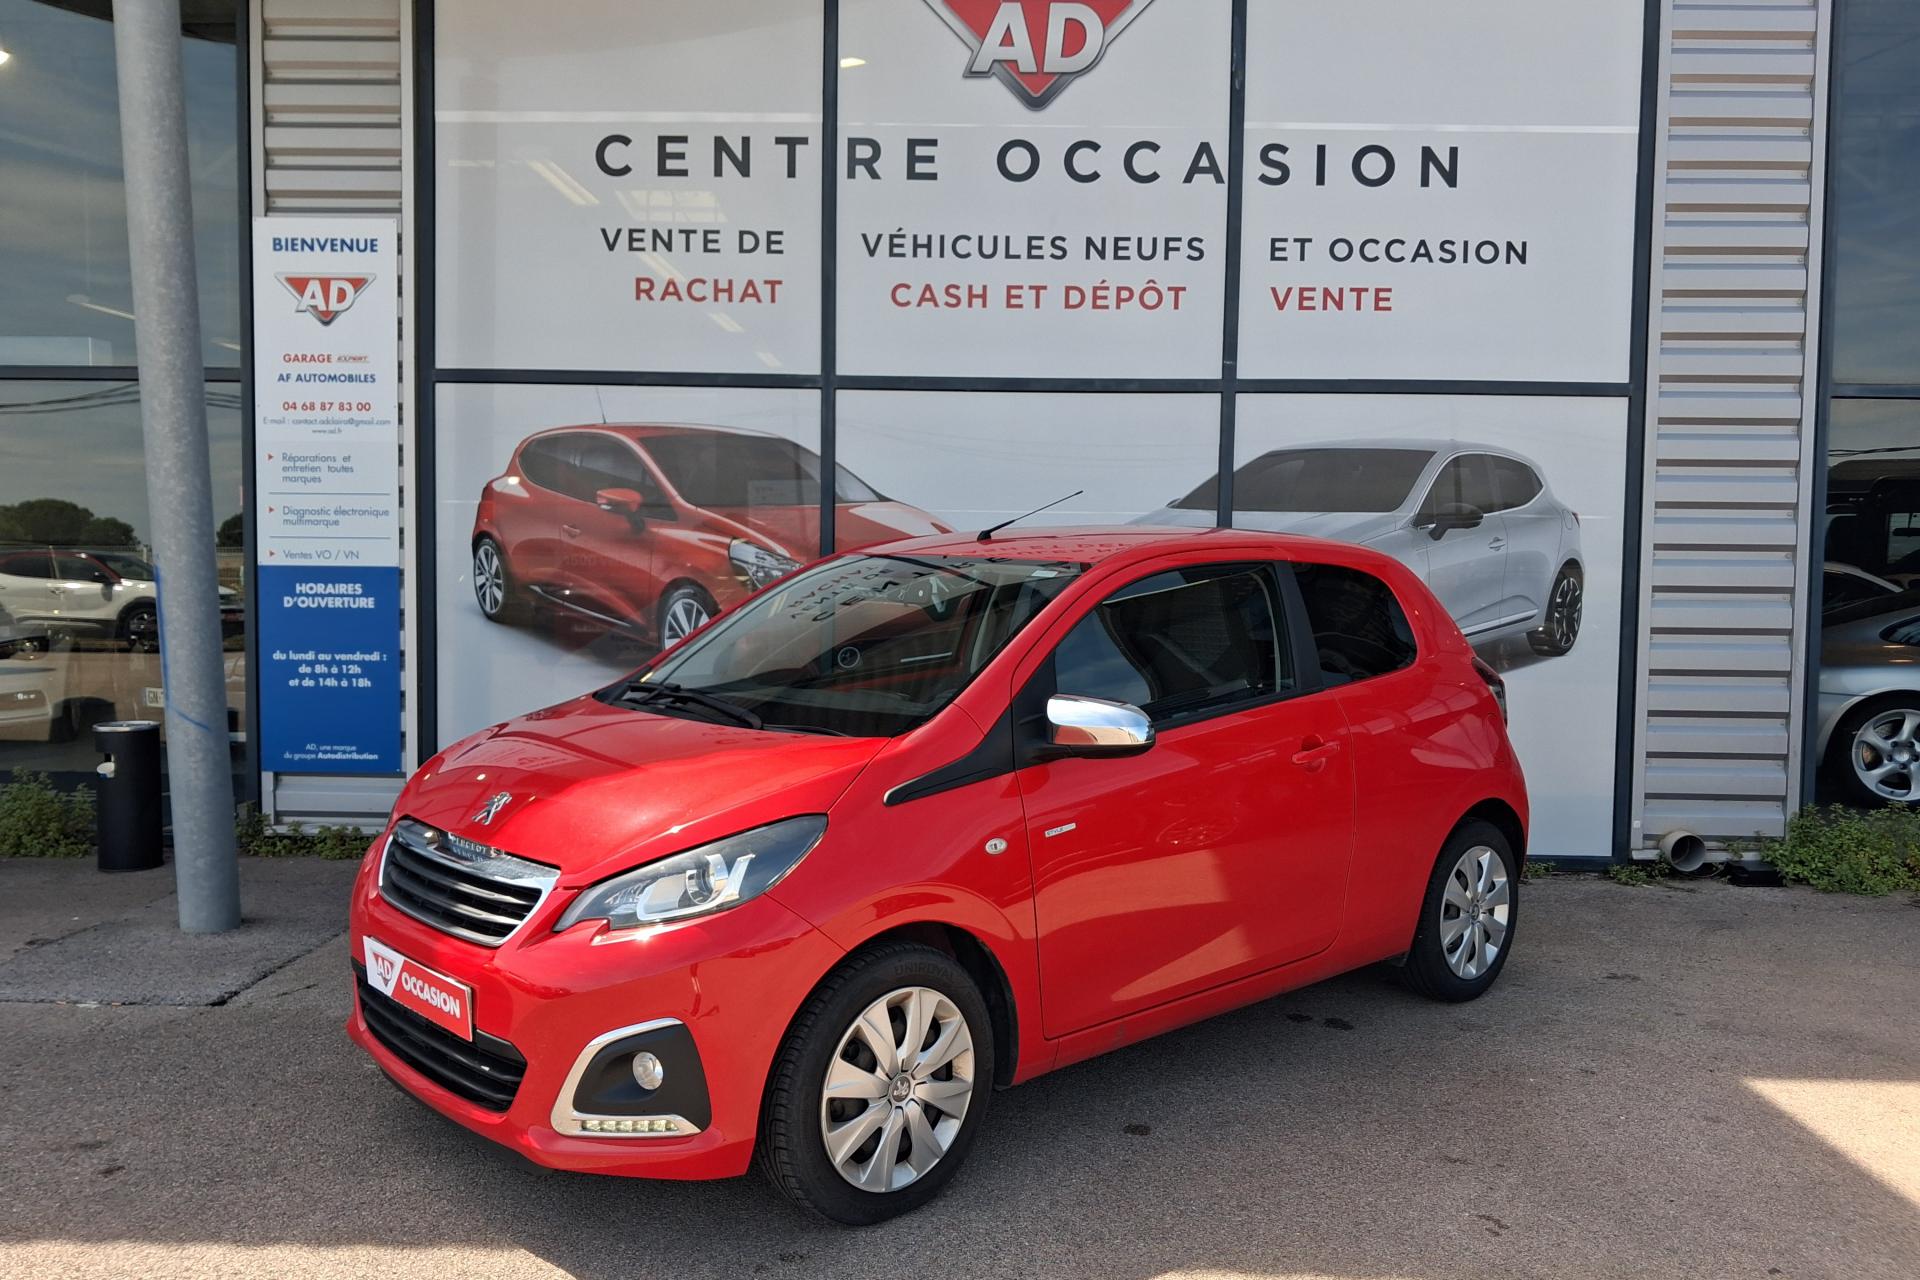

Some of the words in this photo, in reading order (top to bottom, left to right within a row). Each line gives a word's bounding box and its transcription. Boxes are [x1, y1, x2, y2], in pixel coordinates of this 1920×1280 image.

[971, 1, 1105, 73] AD
[595, 134, 939, 181] CENTRE
[997, 139, 1459, 188] OCCASION
[272, 237, 379, 252] BIENVENUE
[600, 228, 721, 253] VENTE
[738, 230, 784, 254] DE
[861, 228, 1067, 260] VÉHICULES
[1085, 236, 1205, 261] NEUFS
[1269, 238, 1313, 261] ET
[1328, 238, 1528, 265] OCCASION
[296, 278, 356, 313] AD
[635, 277, 783, 303] RACHAT
[891, 283, 988, 308] CASH
[1005, 285, 1048, 309] ET
[1064, 279, 1187, 310] DÉPÔT
[1270, 287, 1393, 312] VENTE
[283, 354, 332, 363] GARAGE
[277, 373, 291, 382] AF
[296, 373, 376, 383] AUTOMOBILES
[282, 402, 297, 411] 04
[301, 402, 316, 411] 68
[319, 402, 334, 411] 87
[338, 402, 353, 411] 83
[356, 402, 371, 411] 00
[282, 452, 336, 465] Réparations
[282, 464, 321, 473] entretien
[328, 465, 354, 473] toutes
[282, 475, 322, 485] marques
[282, 506, 331, 518] Diagnostic
[333, 506, 389, 518] électronique
[283, 517, 340, 528] multimarque
[283, 550, 312, 559] Ventes
[315, 550, 332, 559] VO
[344, 550, 360, 560] VN
[295, 583, 362, 594] HORAIRES
[283, 596, 375, 608] D'OUVERTURE
[272, 651, 287, 660] du
[289, 651, 315, 660] lundi
[334, 652, 380, 661] vendredi
[298, 665, 311, 674] de
[314, 665, 327, 674] 8h
[342, 665, 361, 674] 12h
[289, 679, 299, 687] et
[301, 678, 315, 687] de
[319, 678, 338, 687] 14h
[352, 678, 371, 687] 18h
[317, 752, 378, 760] Autodistribution
[377, 957, 392, 981] AD
[402, 972, 460, 1019] OCCASION
